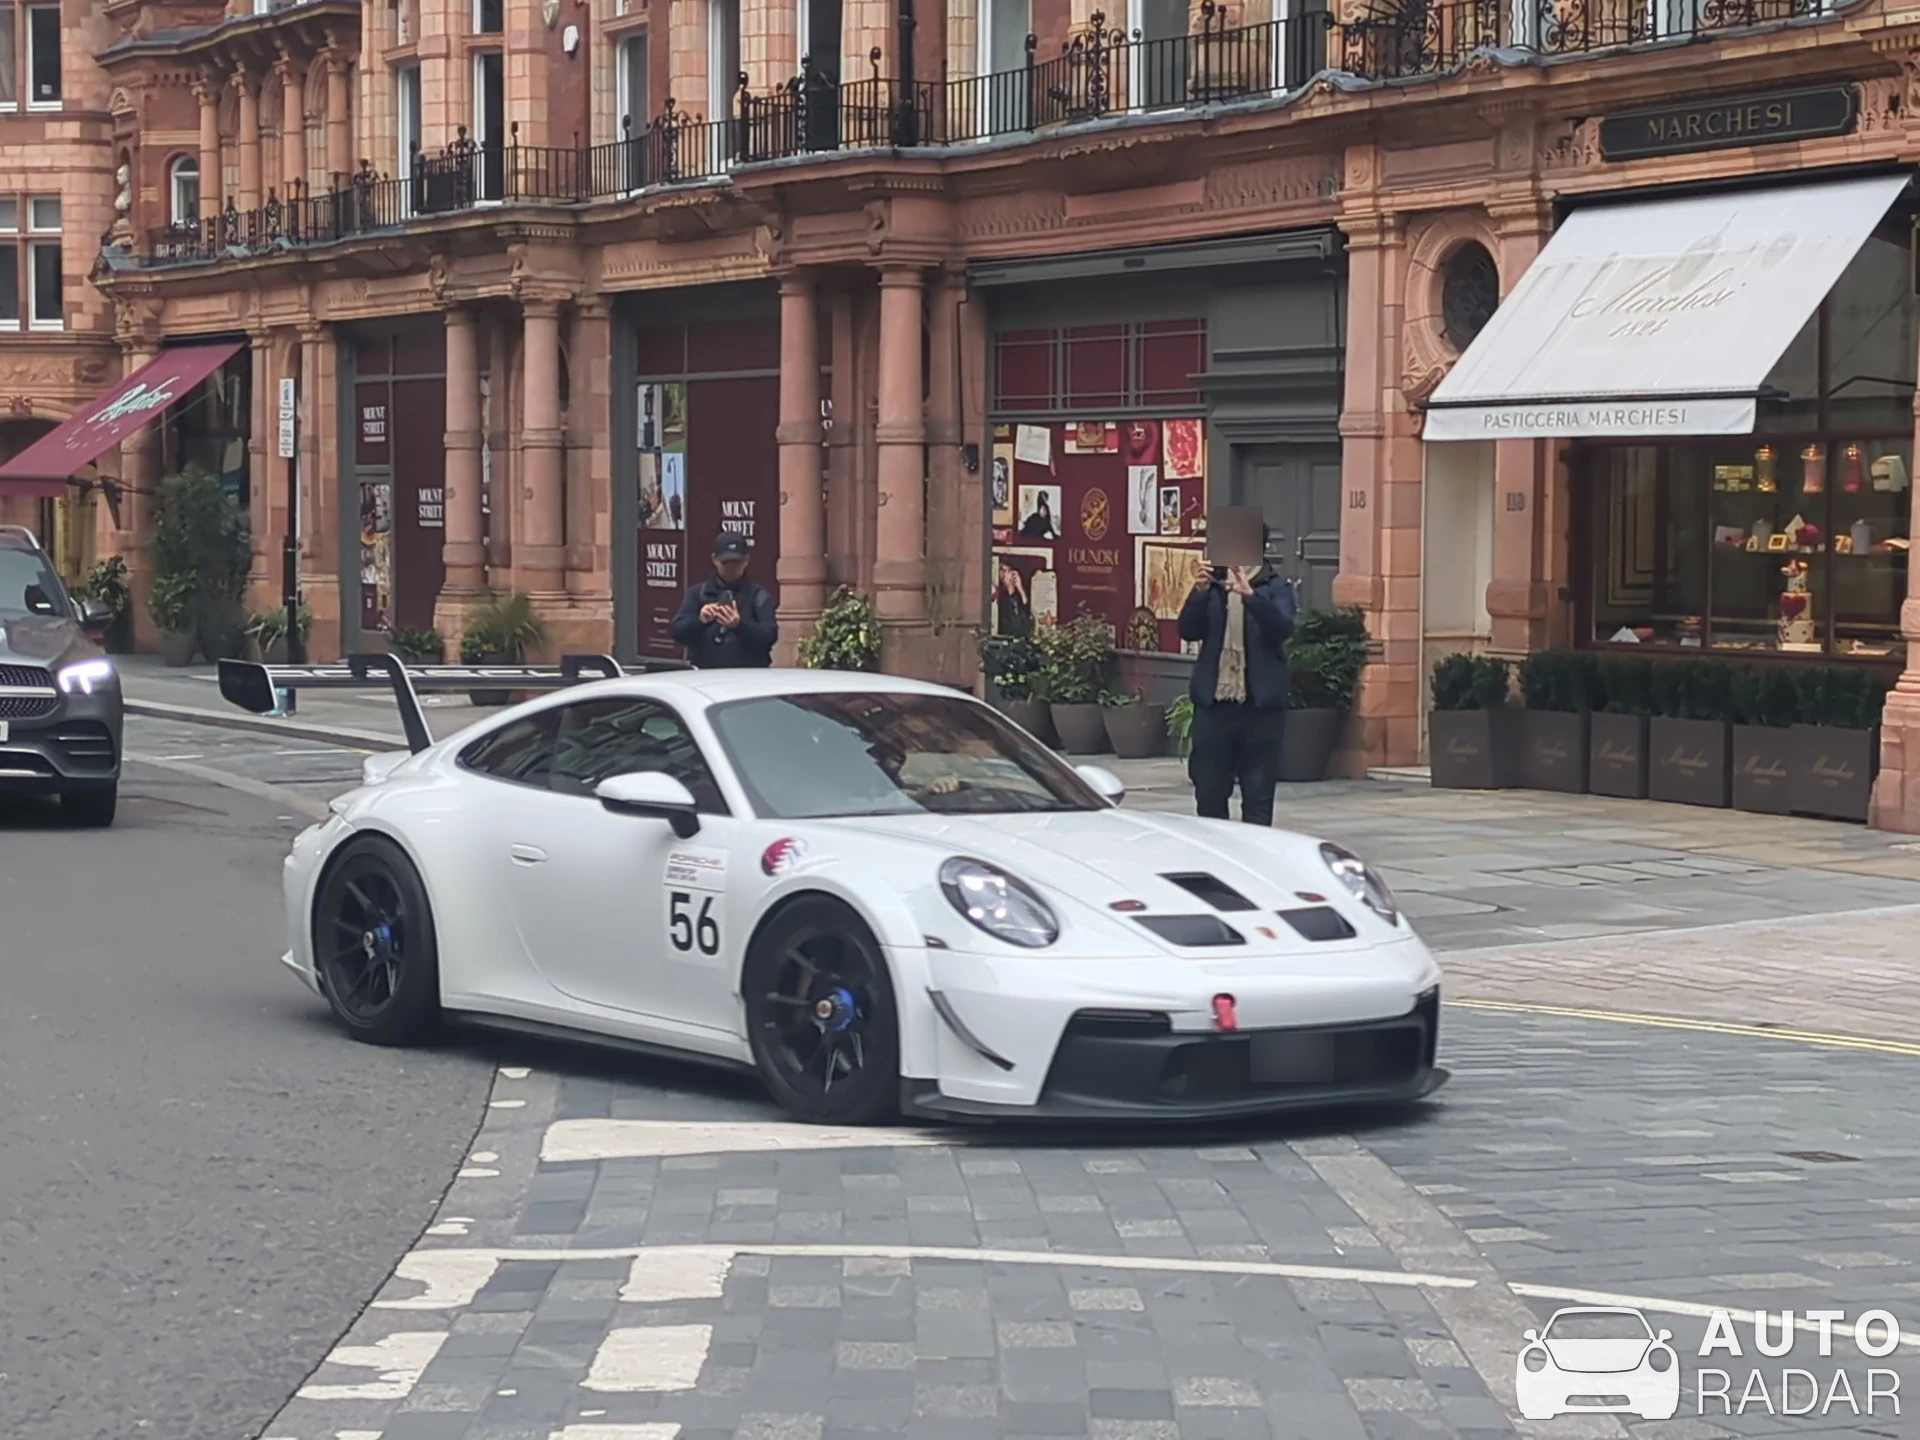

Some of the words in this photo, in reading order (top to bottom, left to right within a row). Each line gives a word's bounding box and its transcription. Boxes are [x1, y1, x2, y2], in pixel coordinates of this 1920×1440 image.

[1648, 102, 1792, 141] MARCHESI
[1570, 265, 1747, 319] Marchesi
[1483, 412, 1580, 429] PASTICCERIA
[1589, 408, 1686, 426] MARCHESI
[418, 488, 442, 502] MOUNT
[722, 500, 756, 518] MOUNT
[646, 543, 678, 560] MOUNT
[646, 562, 678, 578] STREET
[670, 891, 720, 956] 56
